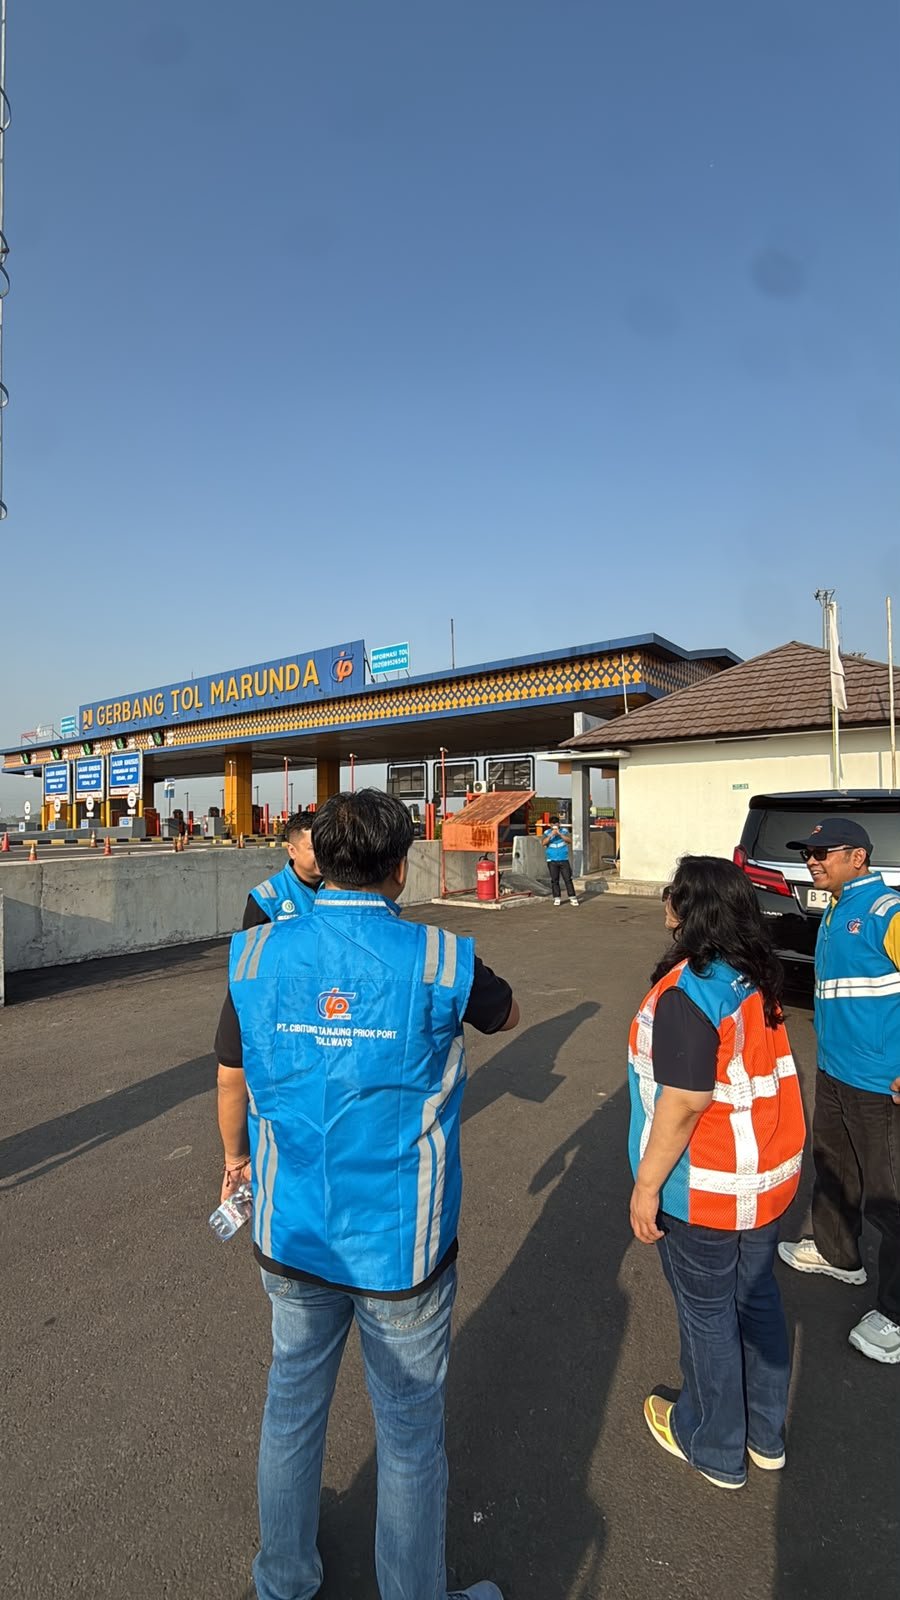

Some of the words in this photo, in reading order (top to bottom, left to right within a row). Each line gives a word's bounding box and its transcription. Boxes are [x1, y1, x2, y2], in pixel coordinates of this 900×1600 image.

[372, 650, 398, 660] INFORMASI
[96, 693, 165, 726] GERBANG
[171, 685, 203, 712] TOL
[210, 659, 320, 705] MARUNDA
[810, 892, 816, 902] B
[276, 1023, 288, 1033] PT.
[289, 1023, 318, 1035] CIBITUNG
[318, 1026, 351, 1037] TANJUNG
[353, 1028, 376, 1039] PRIOK
[376, 1030, 398, 1040] PORT
[315, 1036, 353, 1047] TOLLWAYS
